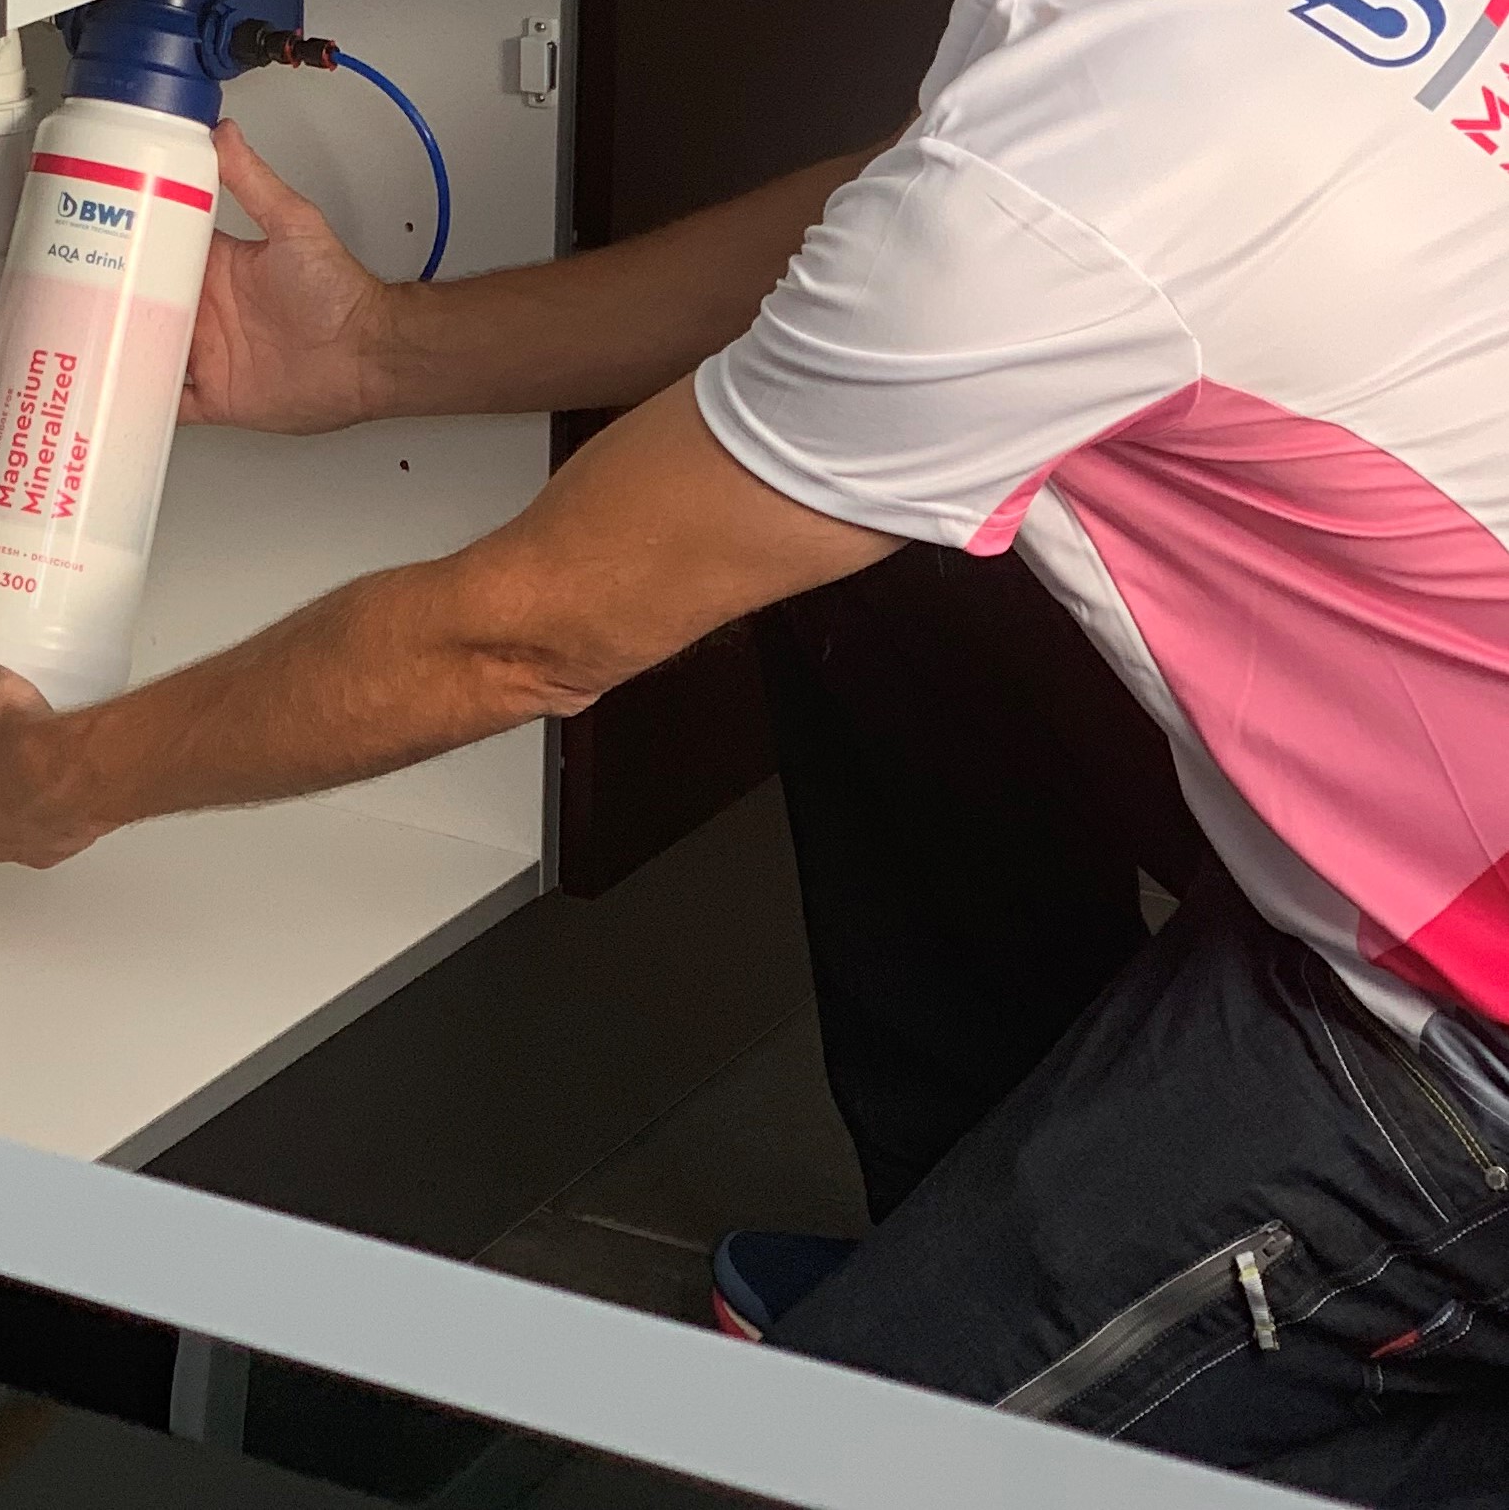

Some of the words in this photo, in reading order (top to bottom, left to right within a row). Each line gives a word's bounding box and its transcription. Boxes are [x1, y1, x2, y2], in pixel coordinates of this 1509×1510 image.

[47, 243, 80, 264] AQA
[85, 250, 126, 271] drink
[20, 352, 78, 515] Mineralized
[51, 431, 90, 519] Water
